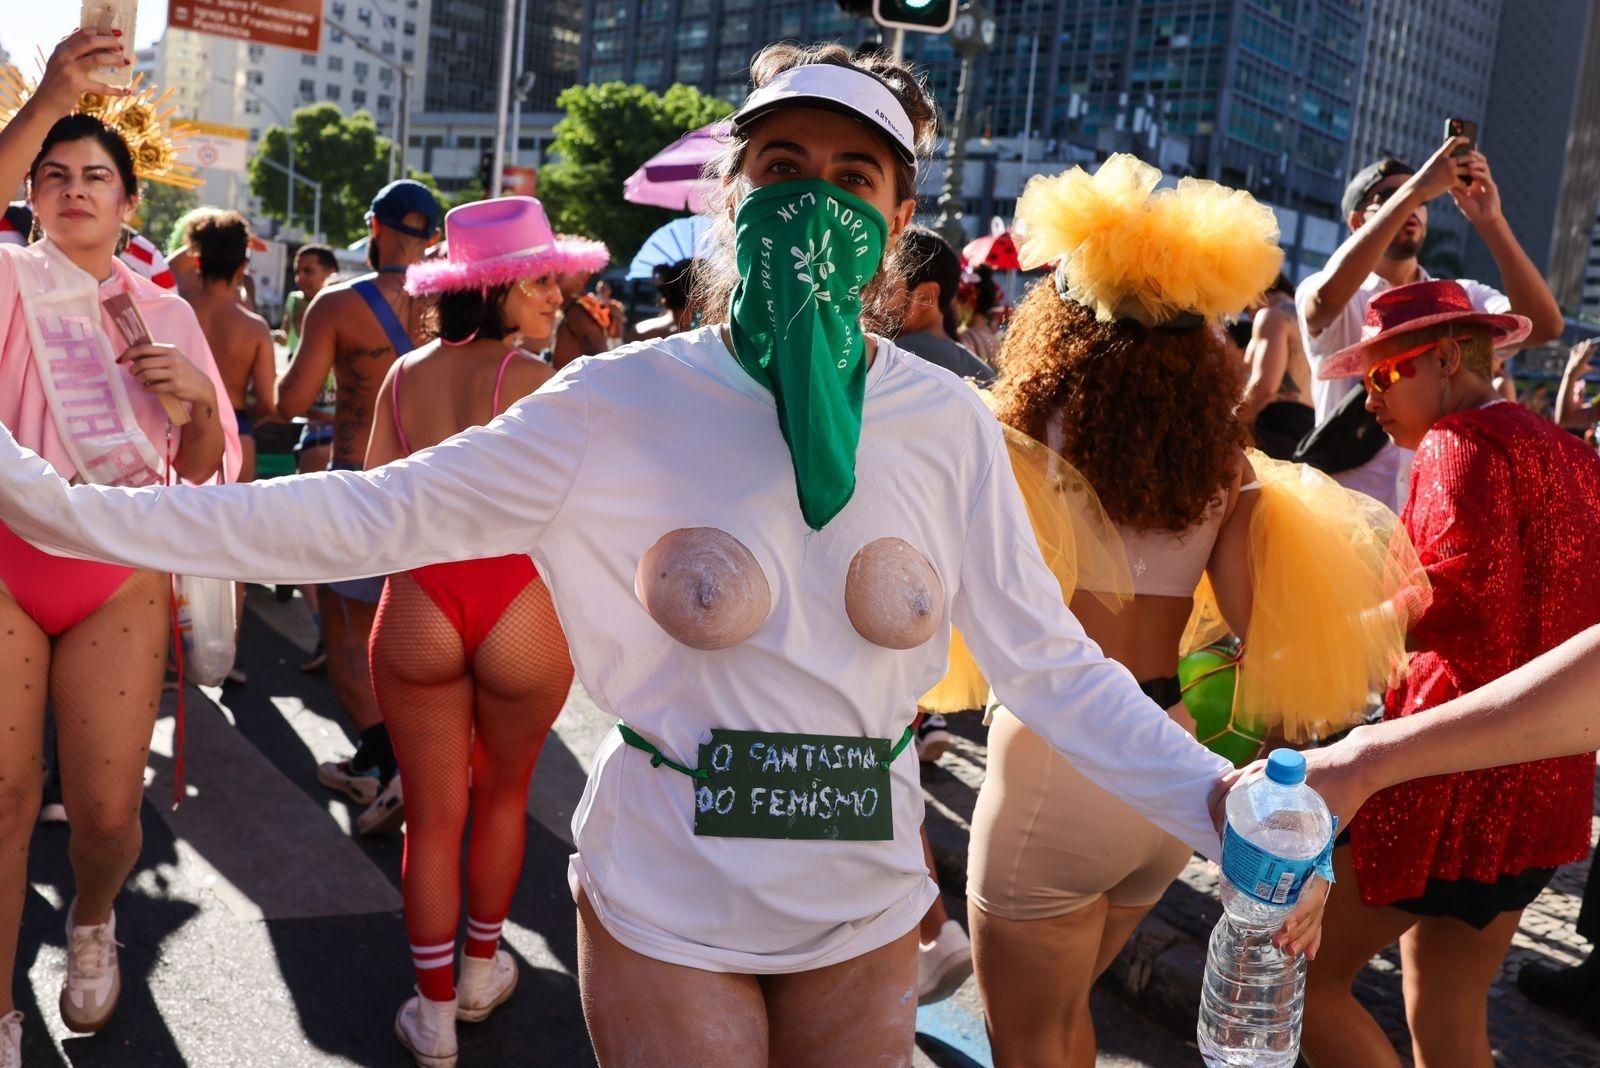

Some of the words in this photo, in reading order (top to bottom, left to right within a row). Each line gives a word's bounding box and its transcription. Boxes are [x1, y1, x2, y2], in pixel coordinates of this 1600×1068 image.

[826, 196, 868, 257] MORTA
[760, 236, 774, 290] PRESA
[834, 304, 852, 369] AORTO
[37, 316, 125, 440] SANTA
[711, 743, 733, 772] O
[749, 742, 878, 773] FANTASMA
